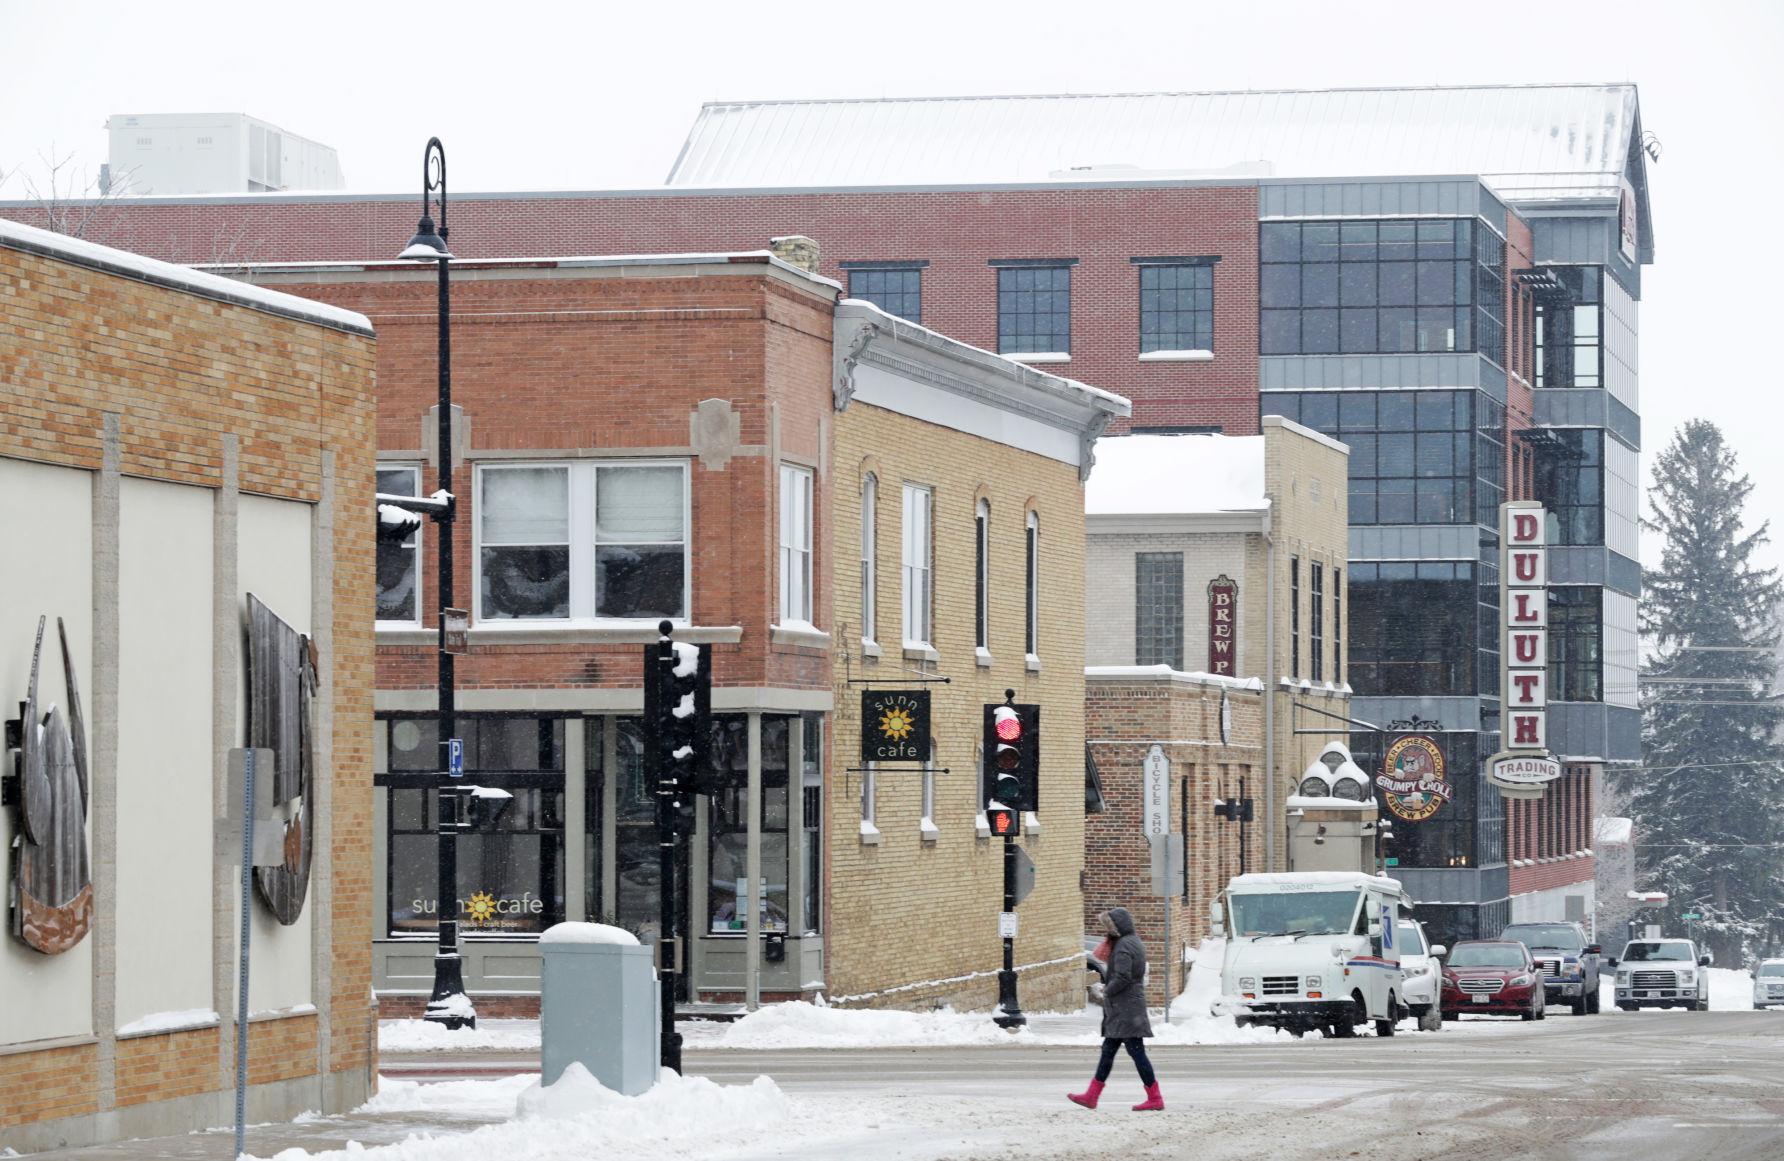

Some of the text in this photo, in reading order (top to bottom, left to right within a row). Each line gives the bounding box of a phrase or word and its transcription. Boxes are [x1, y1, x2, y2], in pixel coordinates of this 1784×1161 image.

[1213, 593, 1232, 654] BREW
[1513, 514, 1539, 743] DULUTH
[874, 695, 918, 711] sunn
[452, 741, 461, 764] P
[877, 741, 917, 757] cafe
[1387, 738, 1443, 777] BEER CHEER FOOD
[1499, 762, 1556, 775] TRADING
[1152, 755, 1161, 834] BICYCLE SHO
[1376, 775, 1417, 792] GRUMPY
[1388, 796, 1440, 819] BREW PUB
[412, 891, 543, 914] sun cafe
